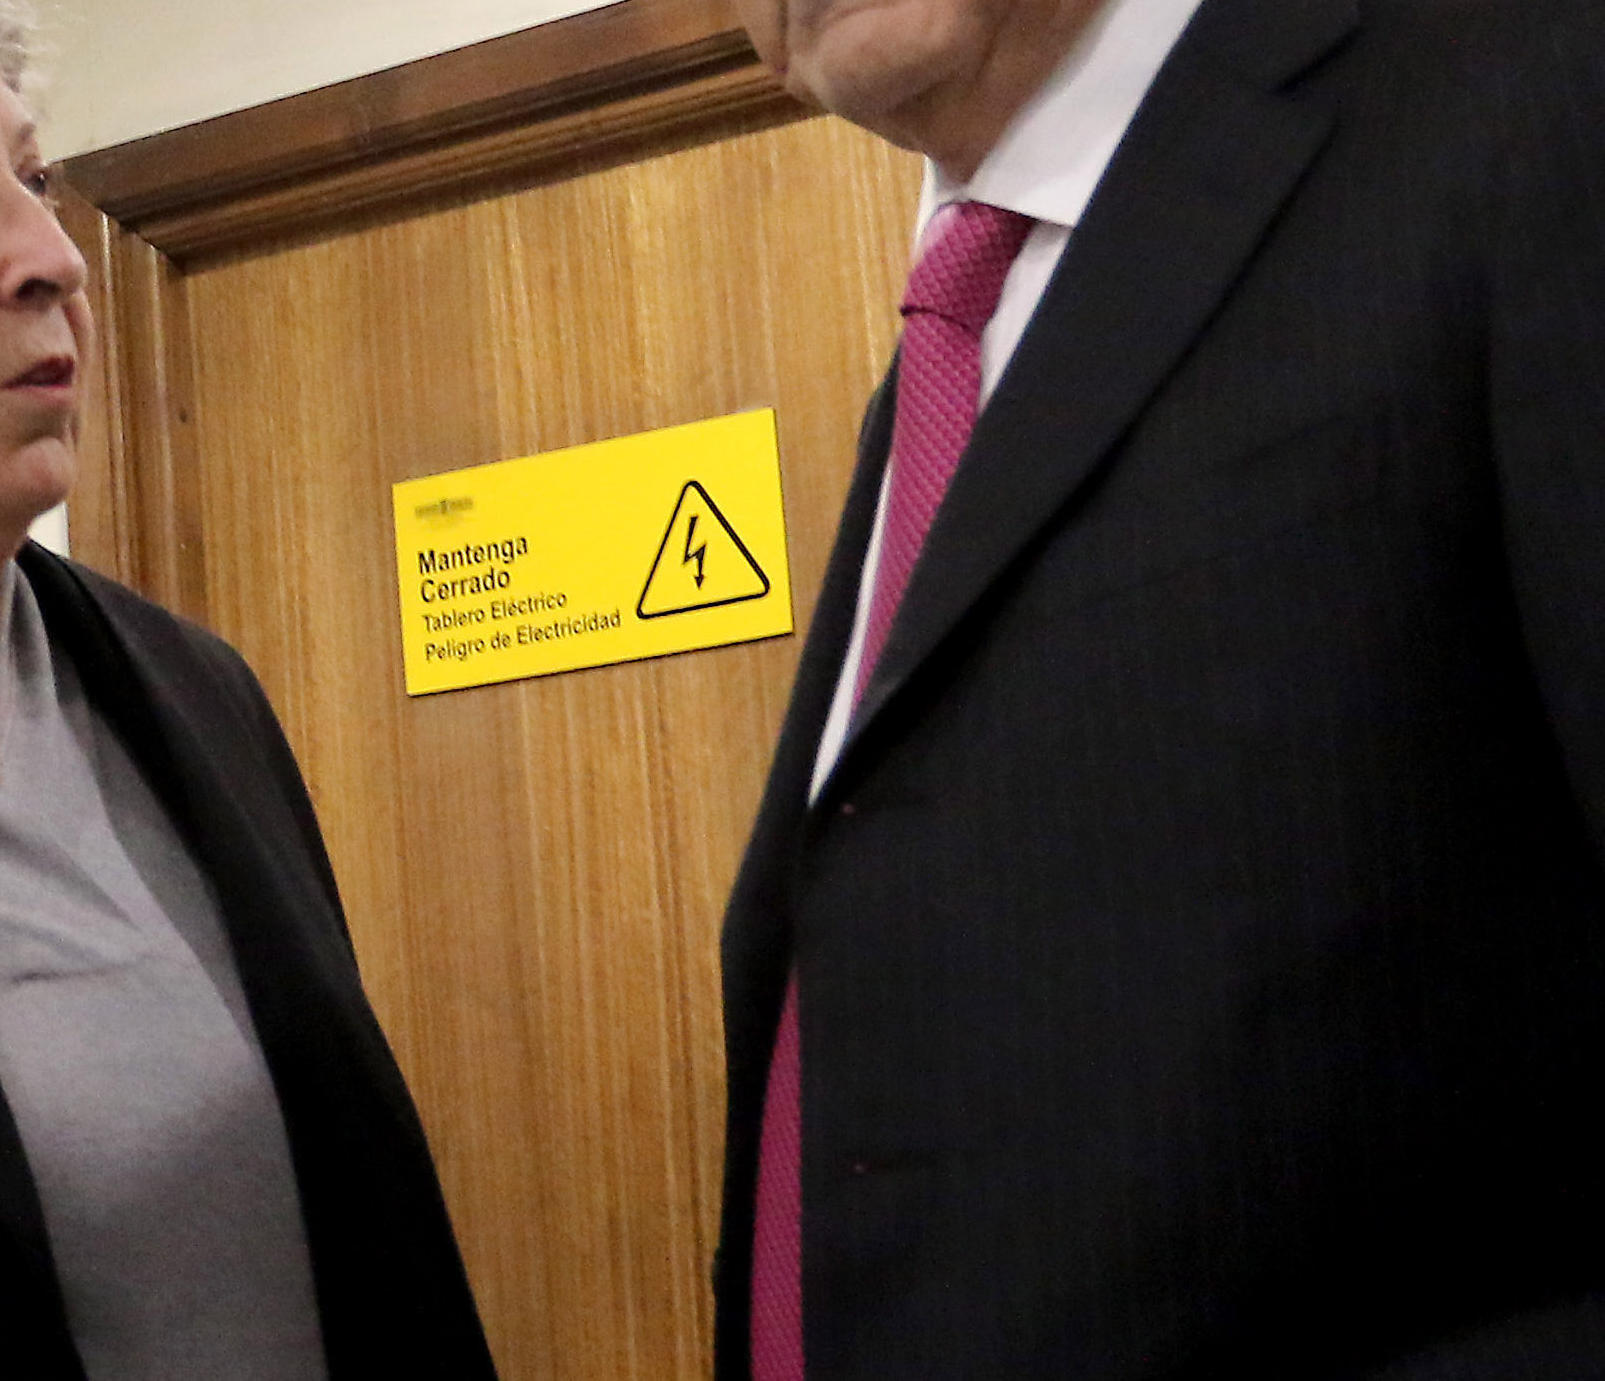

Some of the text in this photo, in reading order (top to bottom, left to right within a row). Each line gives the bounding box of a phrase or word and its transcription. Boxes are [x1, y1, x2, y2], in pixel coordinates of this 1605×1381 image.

[417, 537, 528, 575] Mantenga
[420, 566, 510, 603] Cerrado
[421, 608, 485, 634] Tablero
[425, 609, 622, 662] Peligro de Electricidad
